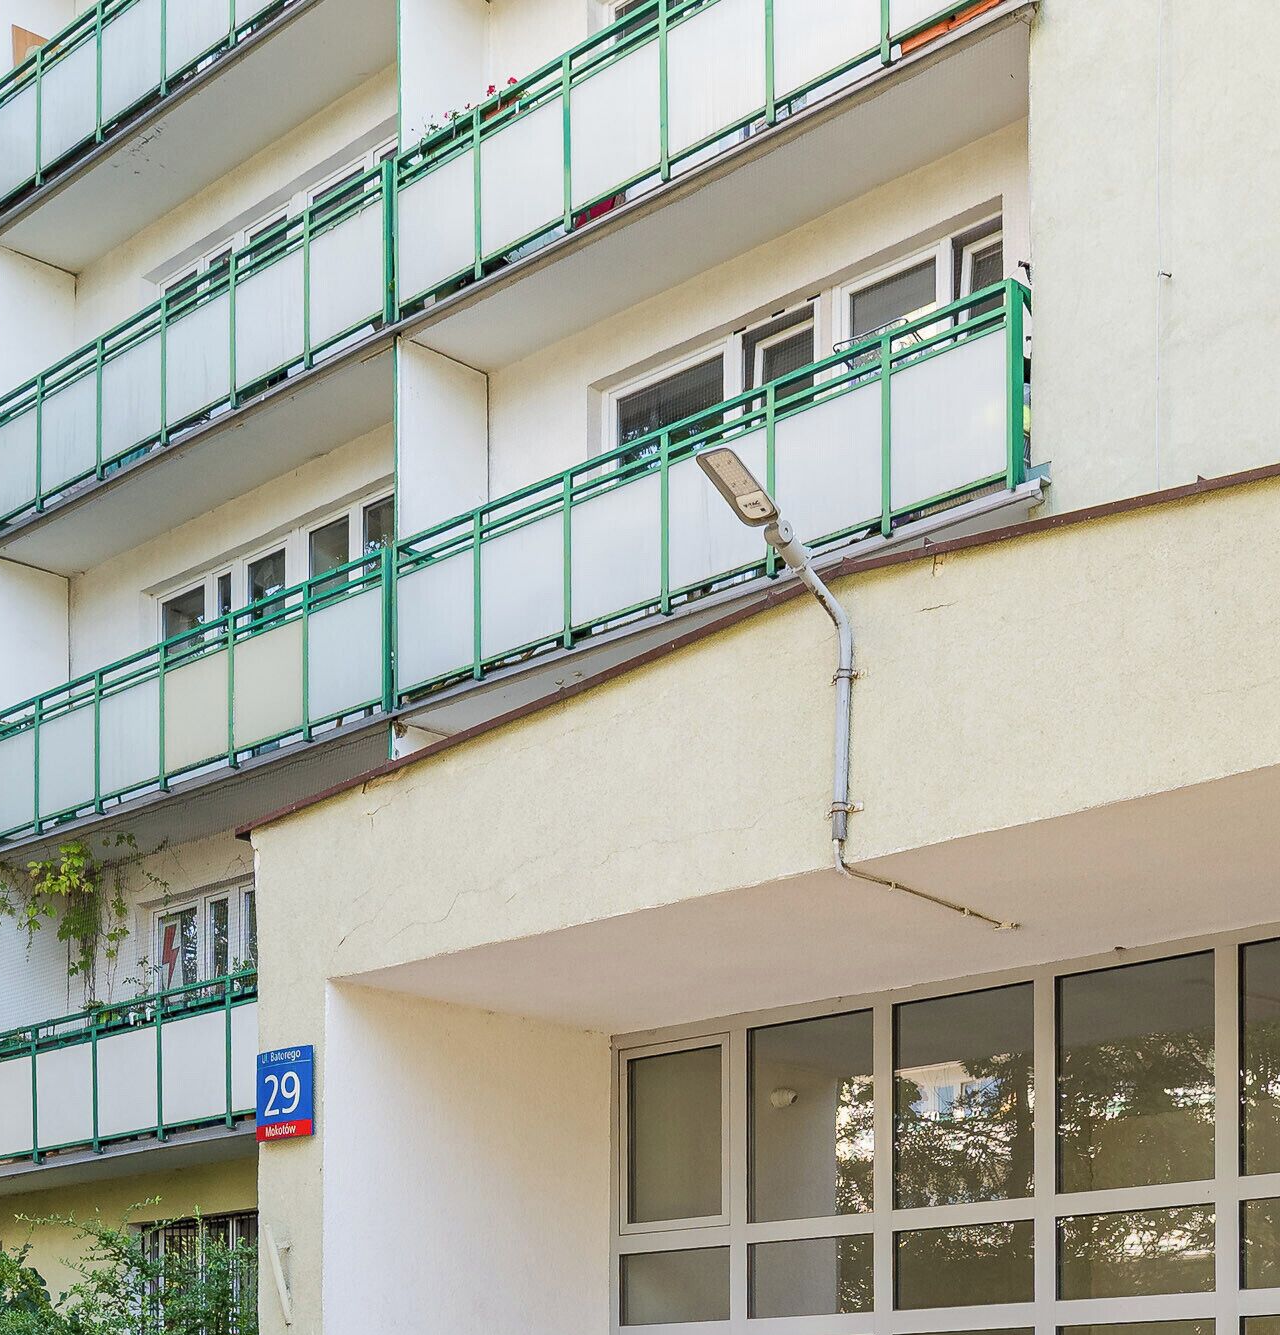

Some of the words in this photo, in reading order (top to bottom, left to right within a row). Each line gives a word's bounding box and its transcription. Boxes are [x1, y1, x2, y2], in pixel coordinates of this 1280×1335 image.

[270, 1050, 301, 1062] Batorego
[264, 1071, 301, 1117] 29
[265, 1124, 296, 1137] Mokotów
